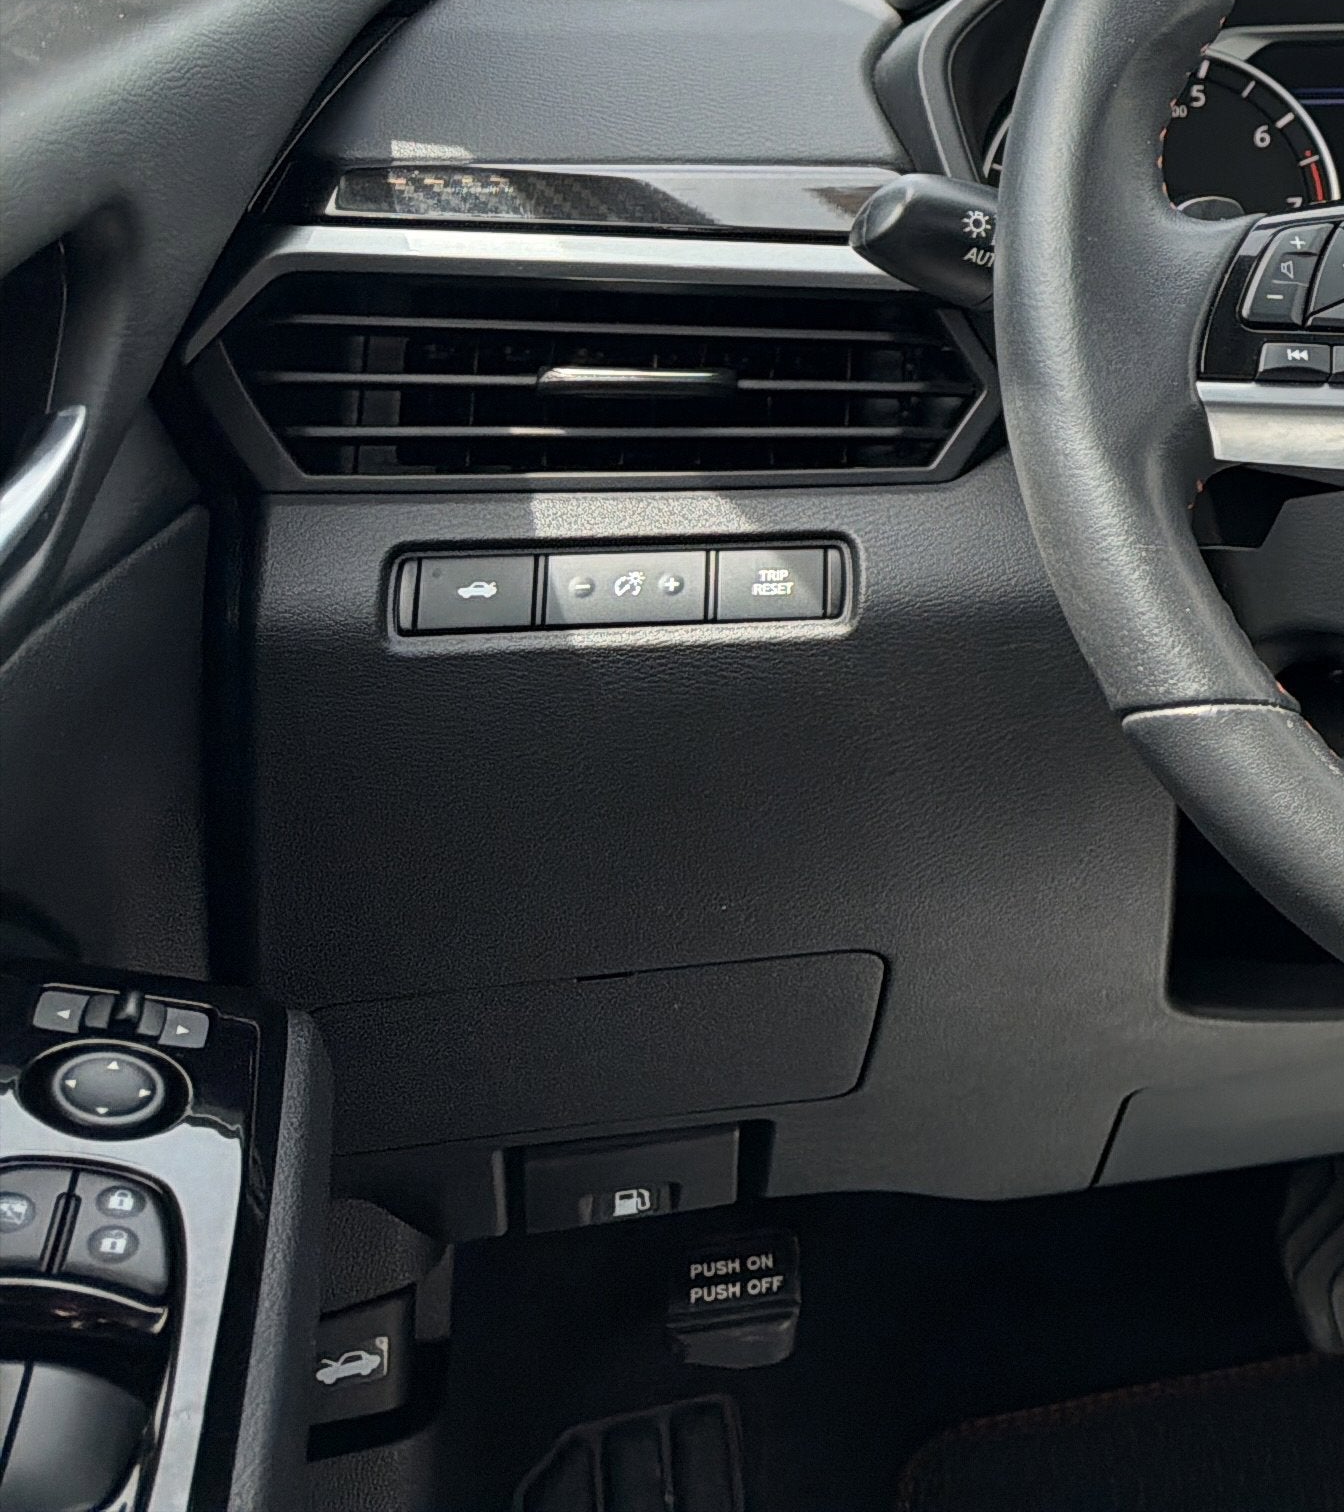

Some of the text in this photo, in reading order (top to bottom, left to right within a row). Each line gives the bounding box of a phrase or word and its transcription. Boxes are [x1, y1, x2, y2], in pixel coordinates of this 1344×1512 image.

[1190, 85, 1206, 108] 5
[1253, 125, 1271, 148] 6
[962, 247, 995, 268] AUT
[758, 569, 789, 581] TRIP
[751, 582, 794, 596] RESET
[690, 1254, 774, 1280] PUSH ON
[690, 1275, 784, 1304] PUSH OFF
